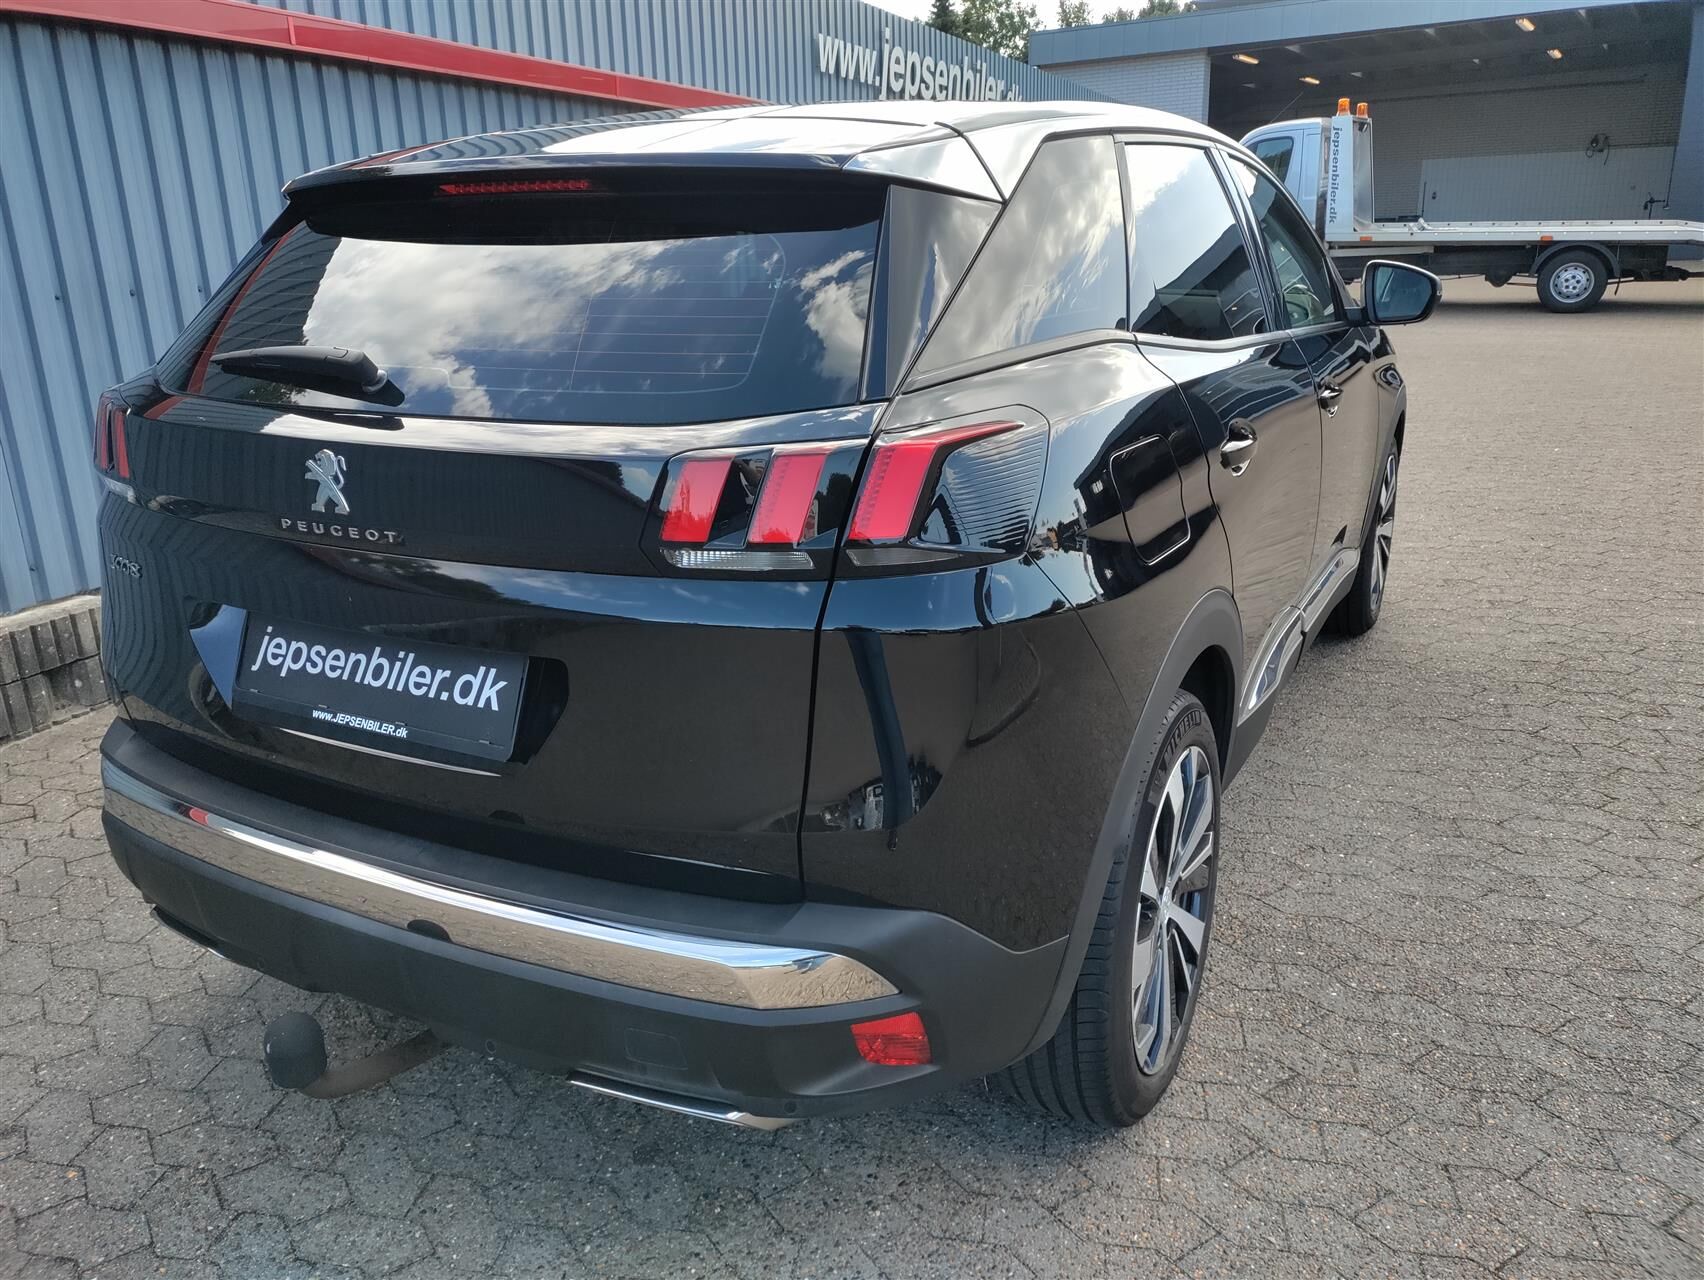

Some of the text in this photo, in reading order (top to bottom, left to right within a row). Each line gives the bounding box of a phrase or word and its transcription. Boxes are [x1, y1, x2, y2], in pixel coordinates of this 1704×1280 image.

[818, 27, 1022, 101] www.jepsenbilerdk
[1328, 126, 1343, 224] jepsenbiler.dk
[281, 518, 397, 543] PEUGEOT
[251, 626, 508, 711] jepsenbiler.dk
[312, 709, 408, 738] www.JEPSENBILER.dk
